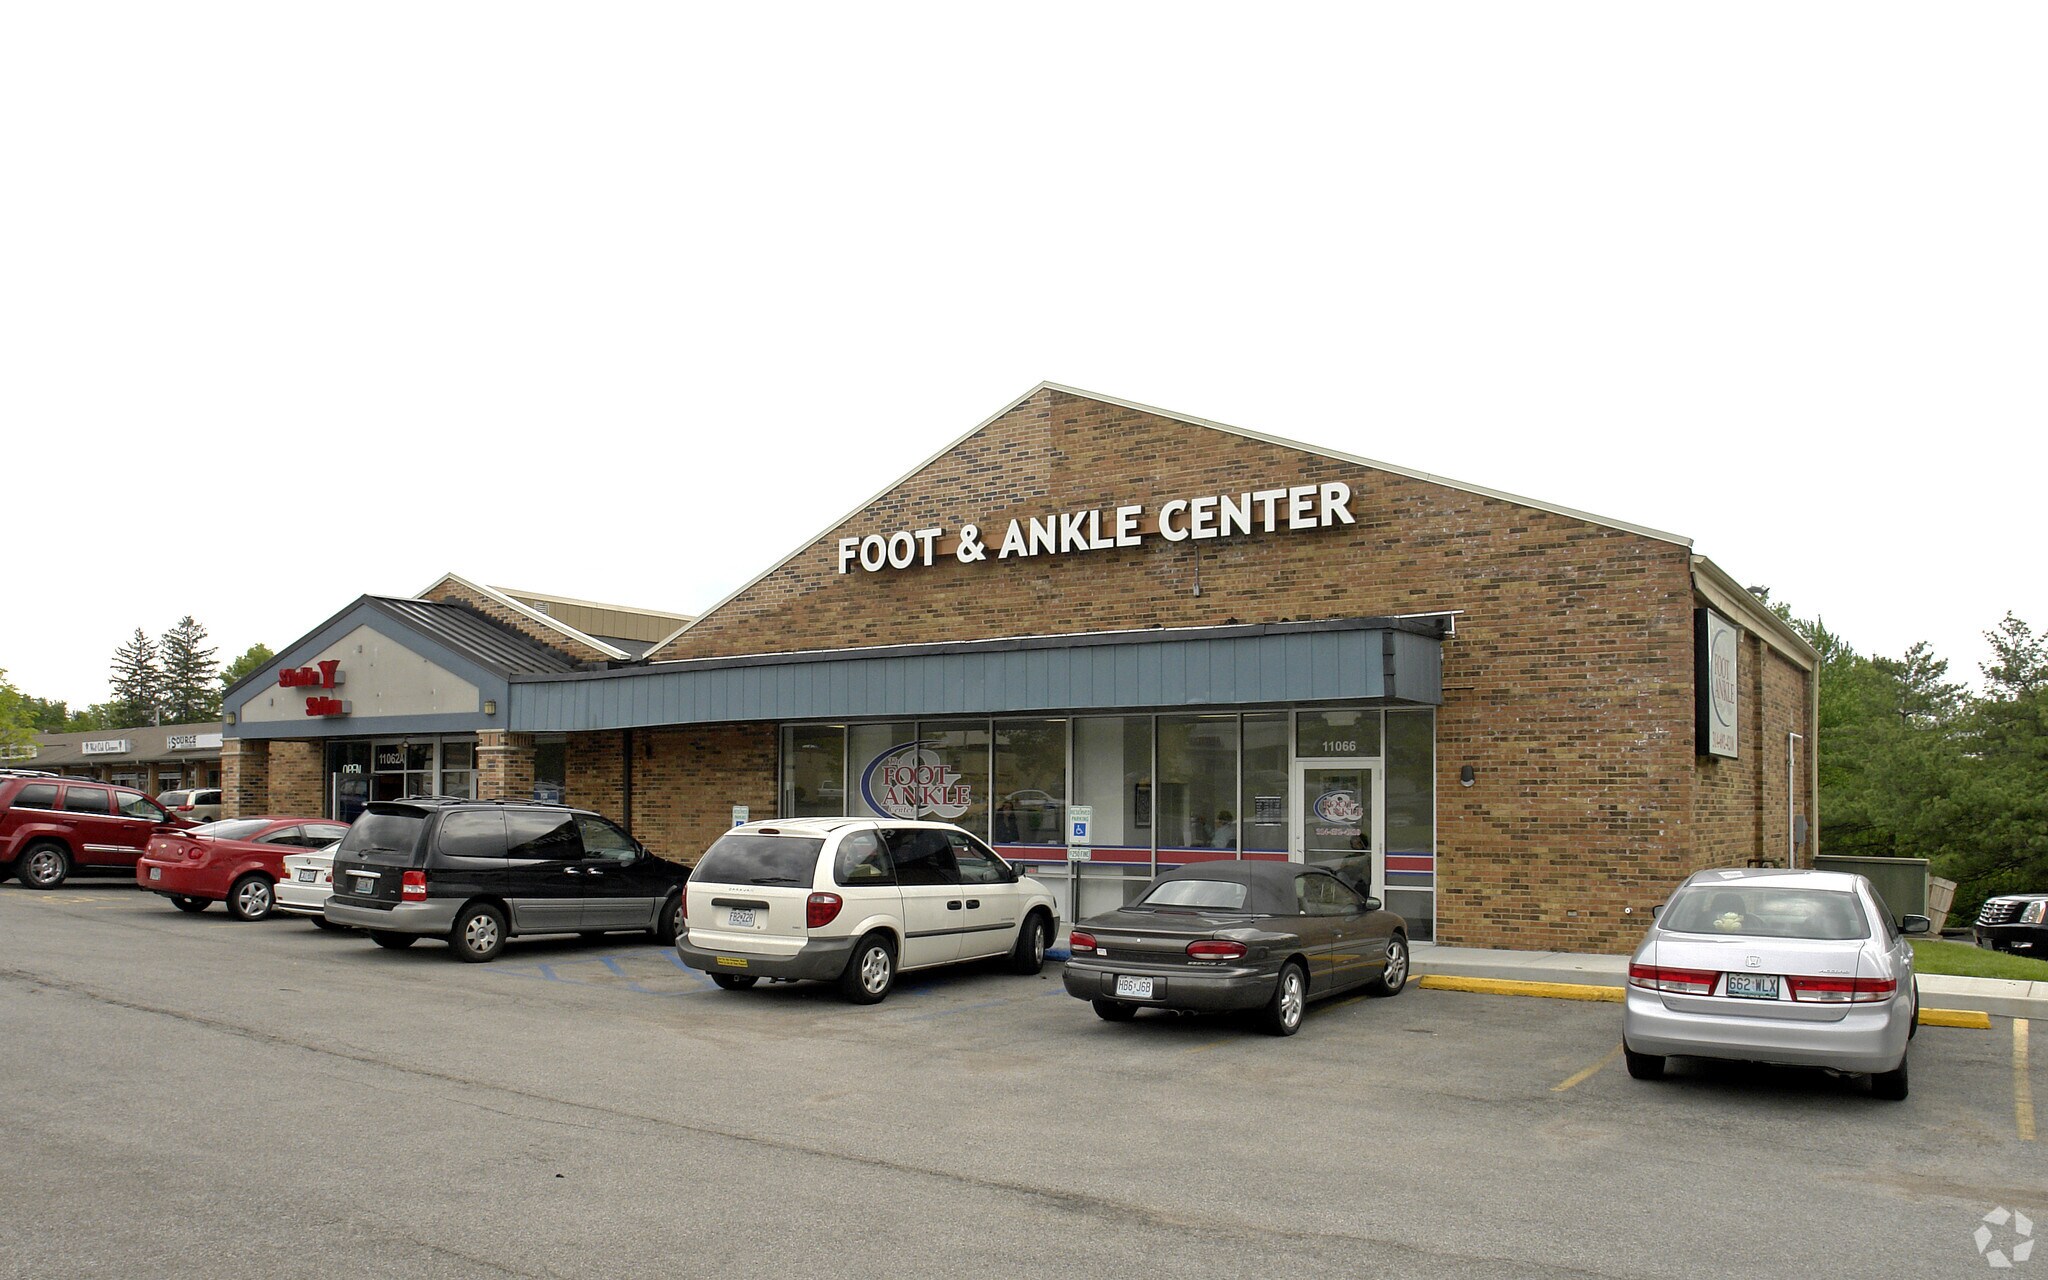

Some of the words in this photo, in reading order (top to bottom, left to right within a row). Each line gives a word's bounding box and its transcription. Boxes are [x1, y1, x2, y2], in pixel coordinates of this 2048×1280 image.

[838, 527, 941, 574] FOOT
[956, 524, 986, 563] &
[999, 504, 1142, 559] ANKLE
[1158, 482, 1355, 542] CENTER
[317, 660, 341, 688] Y
[1714, 654, 1730, 681] FOOT
[1714, 677, 1735, 704] ANKLE
[170, 735, 197, 749] SOURCE
[1322, 741, 1356, 752] 11066
[882, 766, 951, 786] FOOT
[882, 785, 972, 806] ANKLE
[1729, 977, 1751, 990] 662
[1755, 978, 1777, 992] WLX
